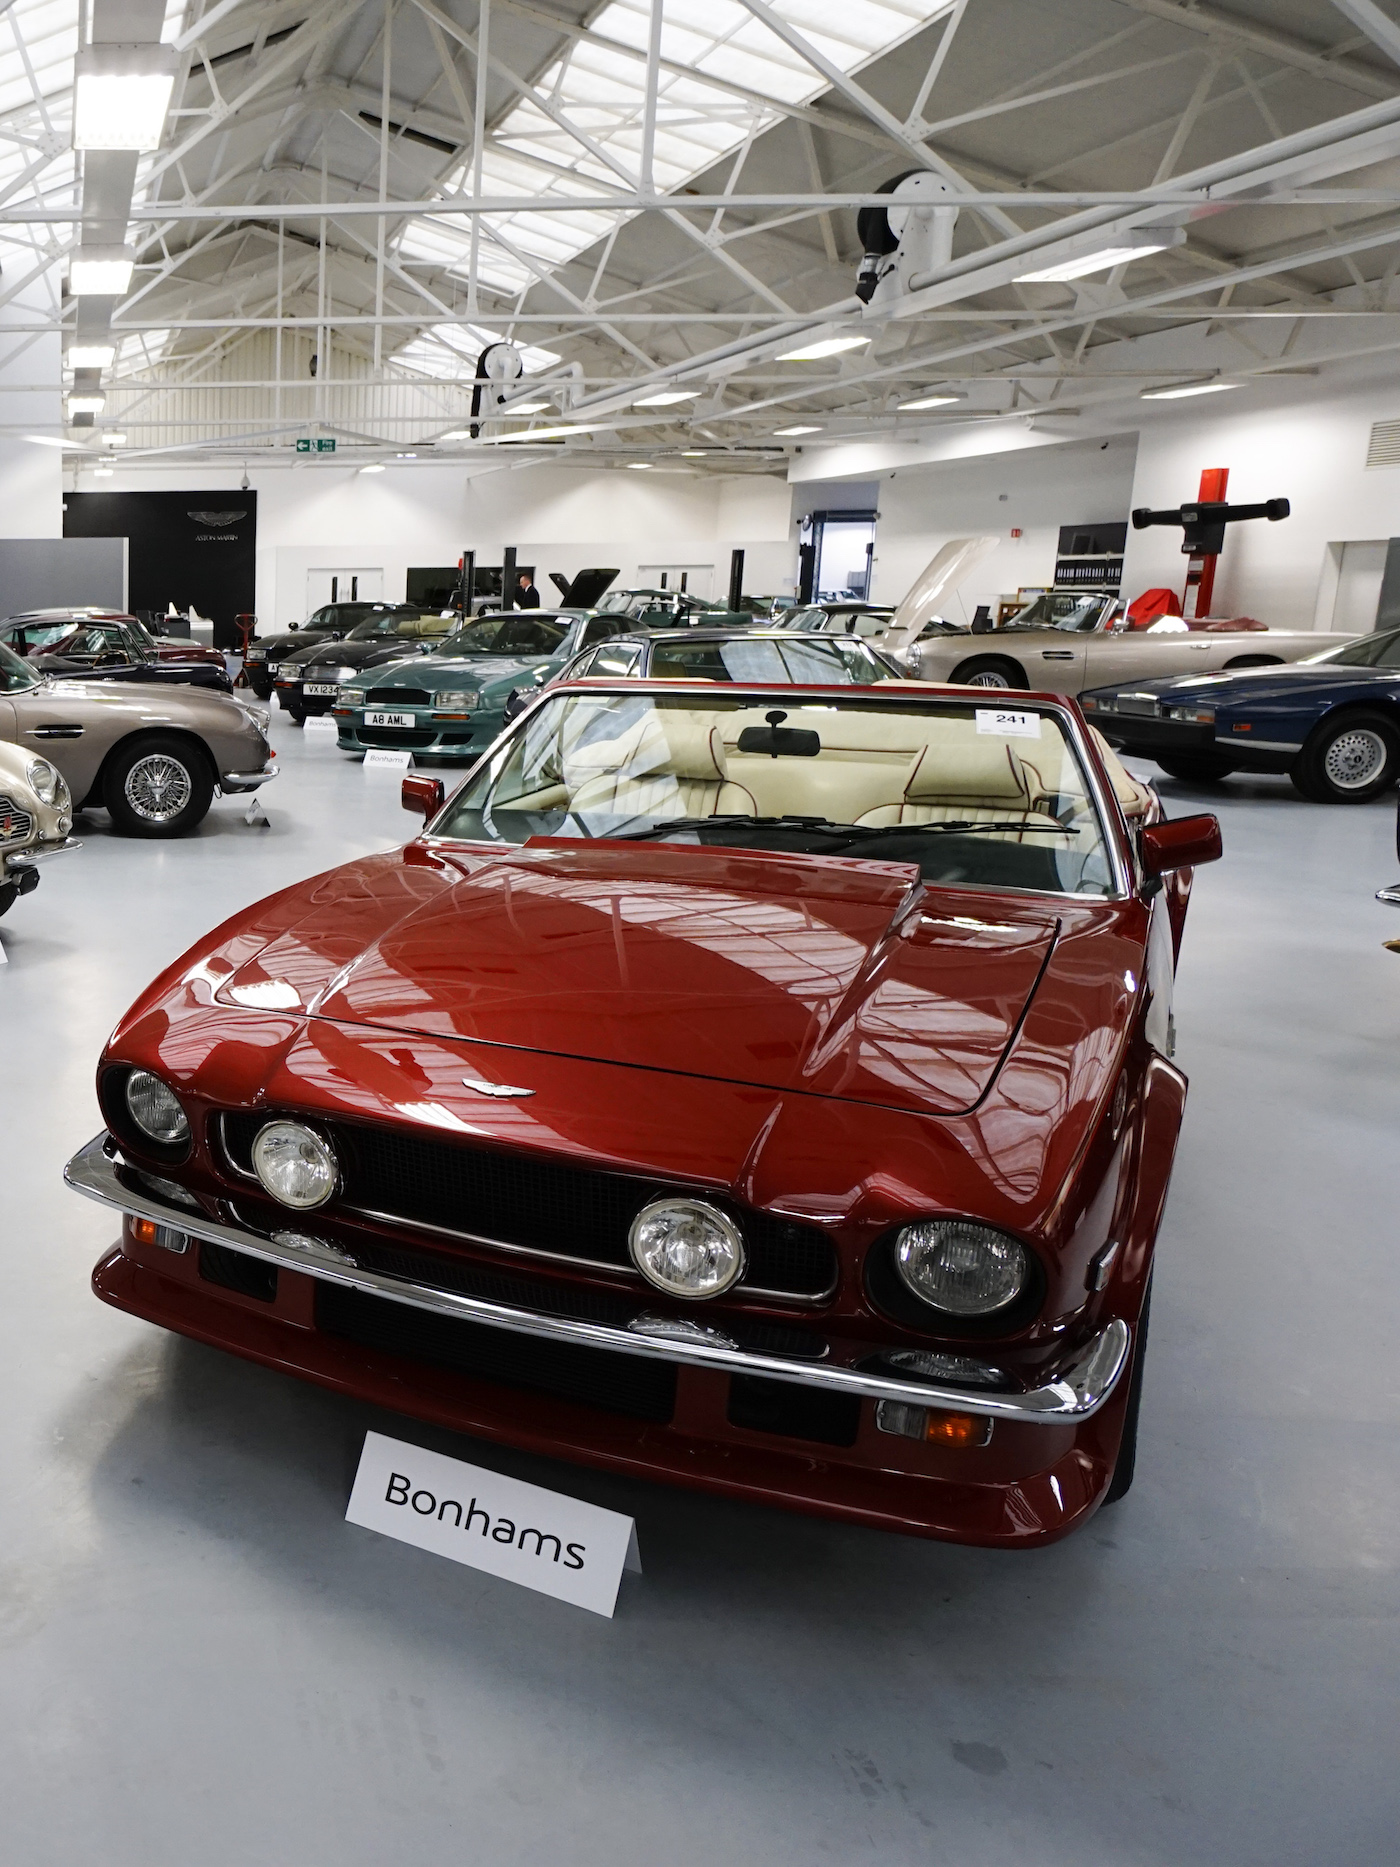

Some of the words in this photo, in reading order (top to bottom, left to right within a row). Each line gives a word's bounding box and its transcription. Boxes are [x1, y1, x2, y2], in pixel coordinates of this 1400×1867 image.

[320, 686, 340, 694] 1234
[372, 714, 385, 724] A8
[387, 715, 407, 726] AML
[996, 714, 1026, 725] 241
[370, 755, 404, 763] Bonhams
[384, 1472, 586, 1570] Bonhams
